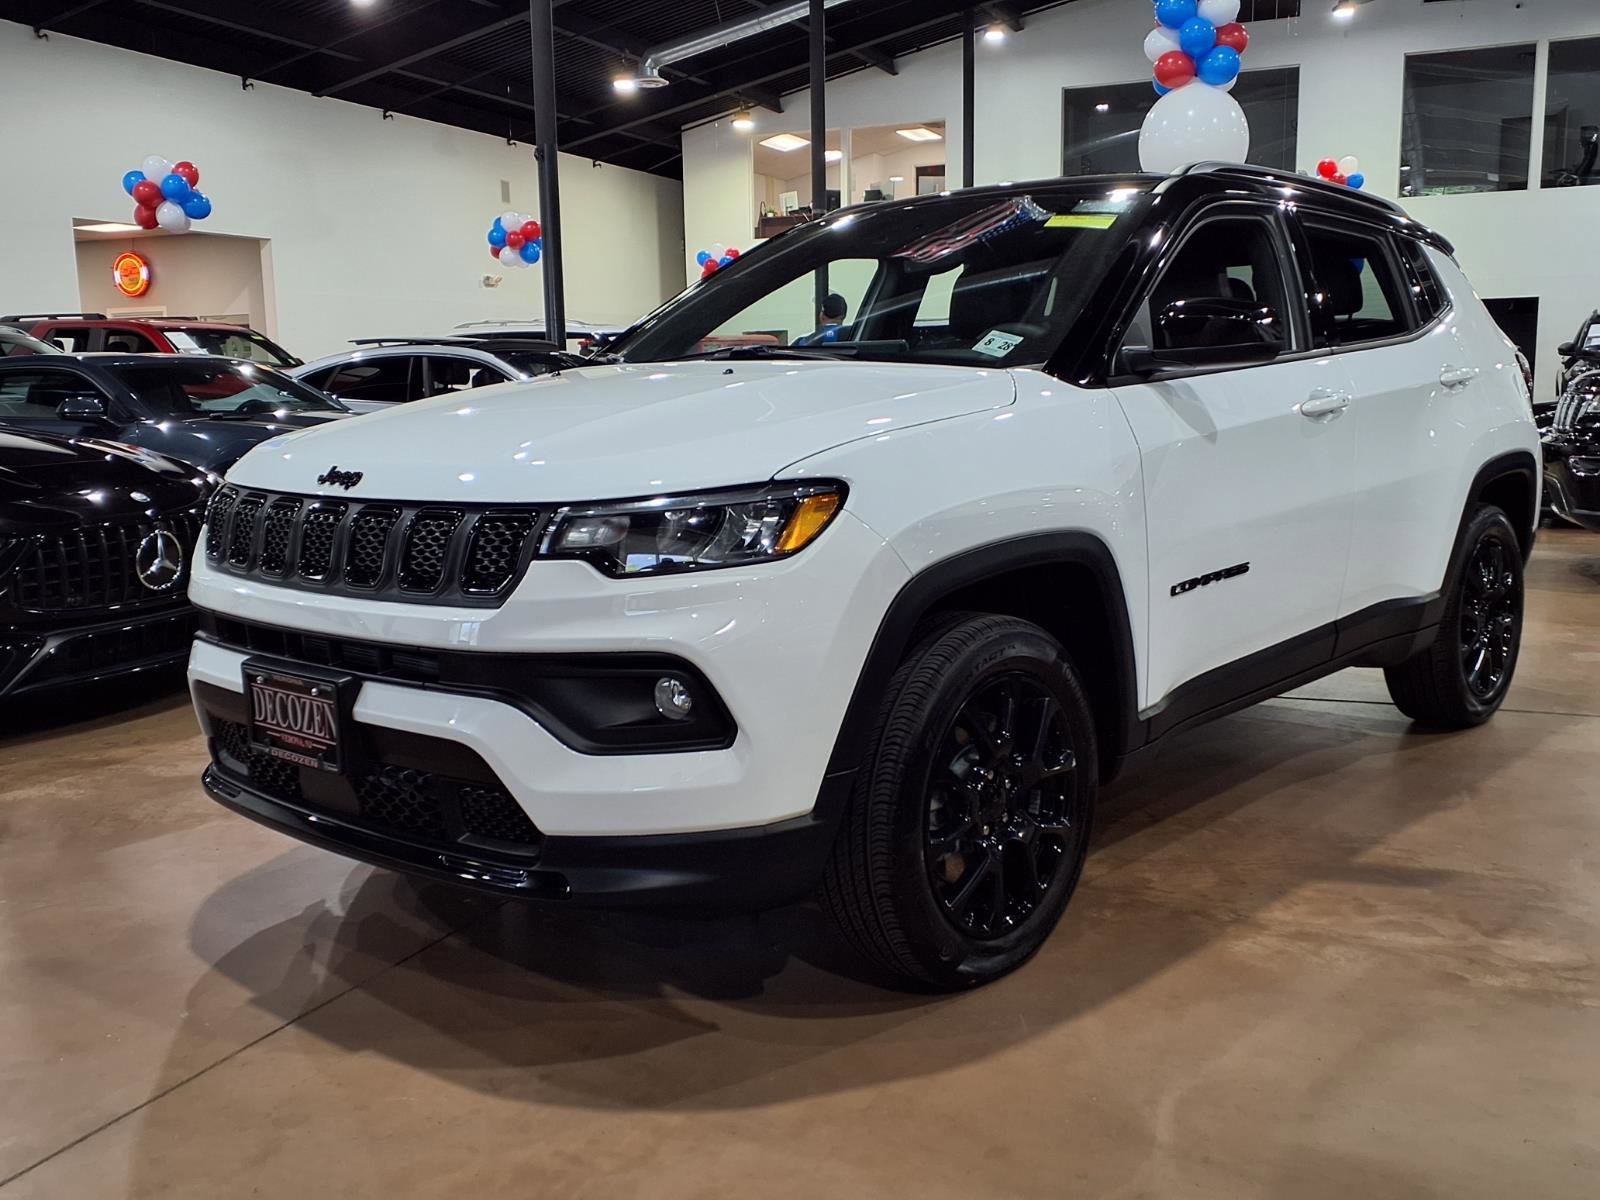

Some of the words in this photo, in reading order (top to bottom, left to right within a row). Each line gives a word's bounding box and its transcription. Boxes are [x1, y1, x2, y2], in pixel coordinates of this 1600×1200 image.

[984, 337, 995, 346] 8
[997, 341, 1014, 351] 28
[317, 466, 363, 491] Jeep
[1170, 561, 1250, 597] COMPASS
[252, 687, 337, 739] DECOZEN
[271, 749, 319, 769] DECOZEN
